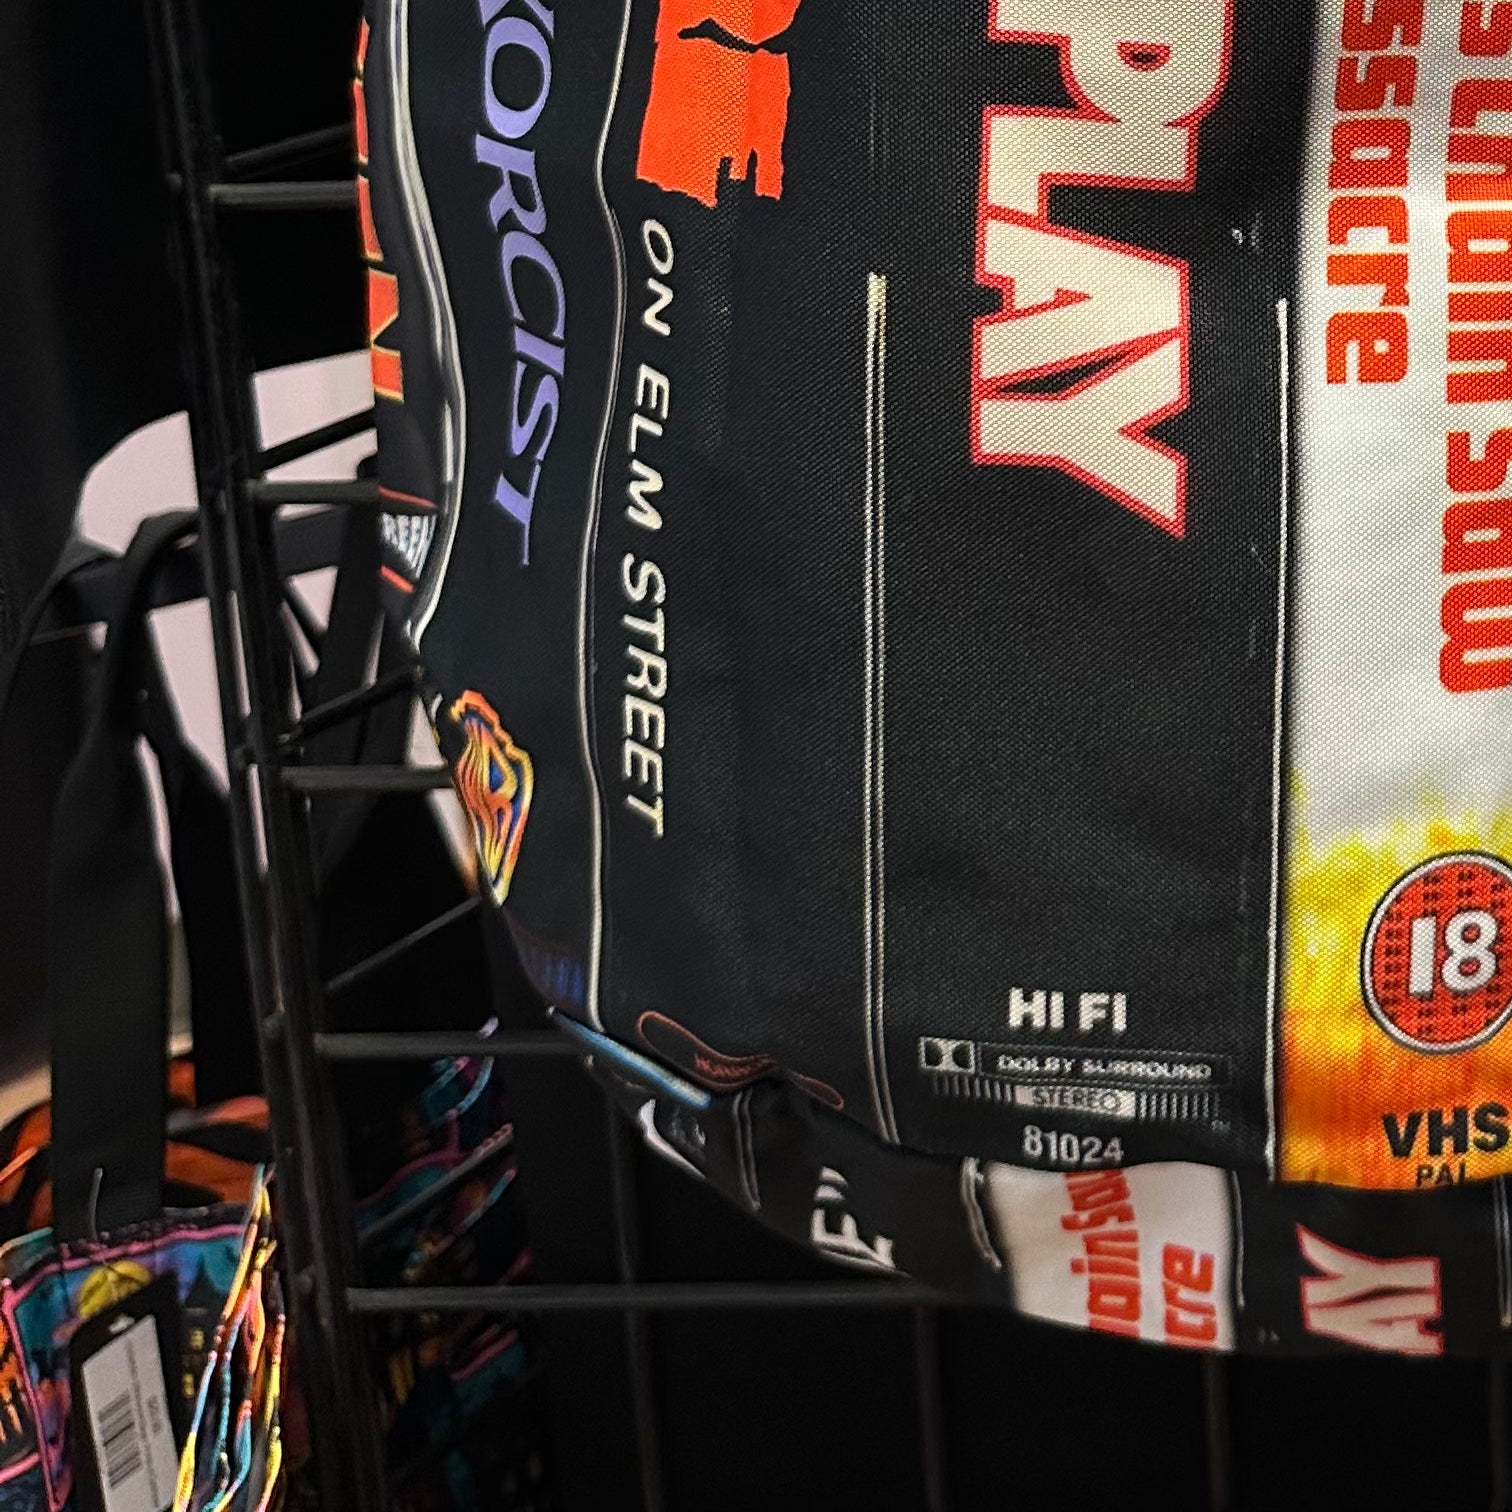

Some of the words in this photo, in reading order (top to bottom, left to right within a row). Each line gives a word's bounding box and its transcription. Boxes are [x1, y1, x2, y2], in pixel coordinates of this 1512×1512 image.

[643, 219, 674, 336] ON
[625, 363, 671, 530] ELM
[621, 552, 668, 839] STREET
[1409, 909, 1498, 999] 18
[1008, 987, 1065, 1031] HI
[1078, 991, 1128, 1034] FI
[997, 1053, 1075, 1074] DOLBY
[1081, 1057, 1213, 1081] SURROUND
[1031, 1088, 1124, 1114] STEREO
[1382, 1100, 1512, 1158] VHS
[1022, 1123, 1125, 1165] 81024
